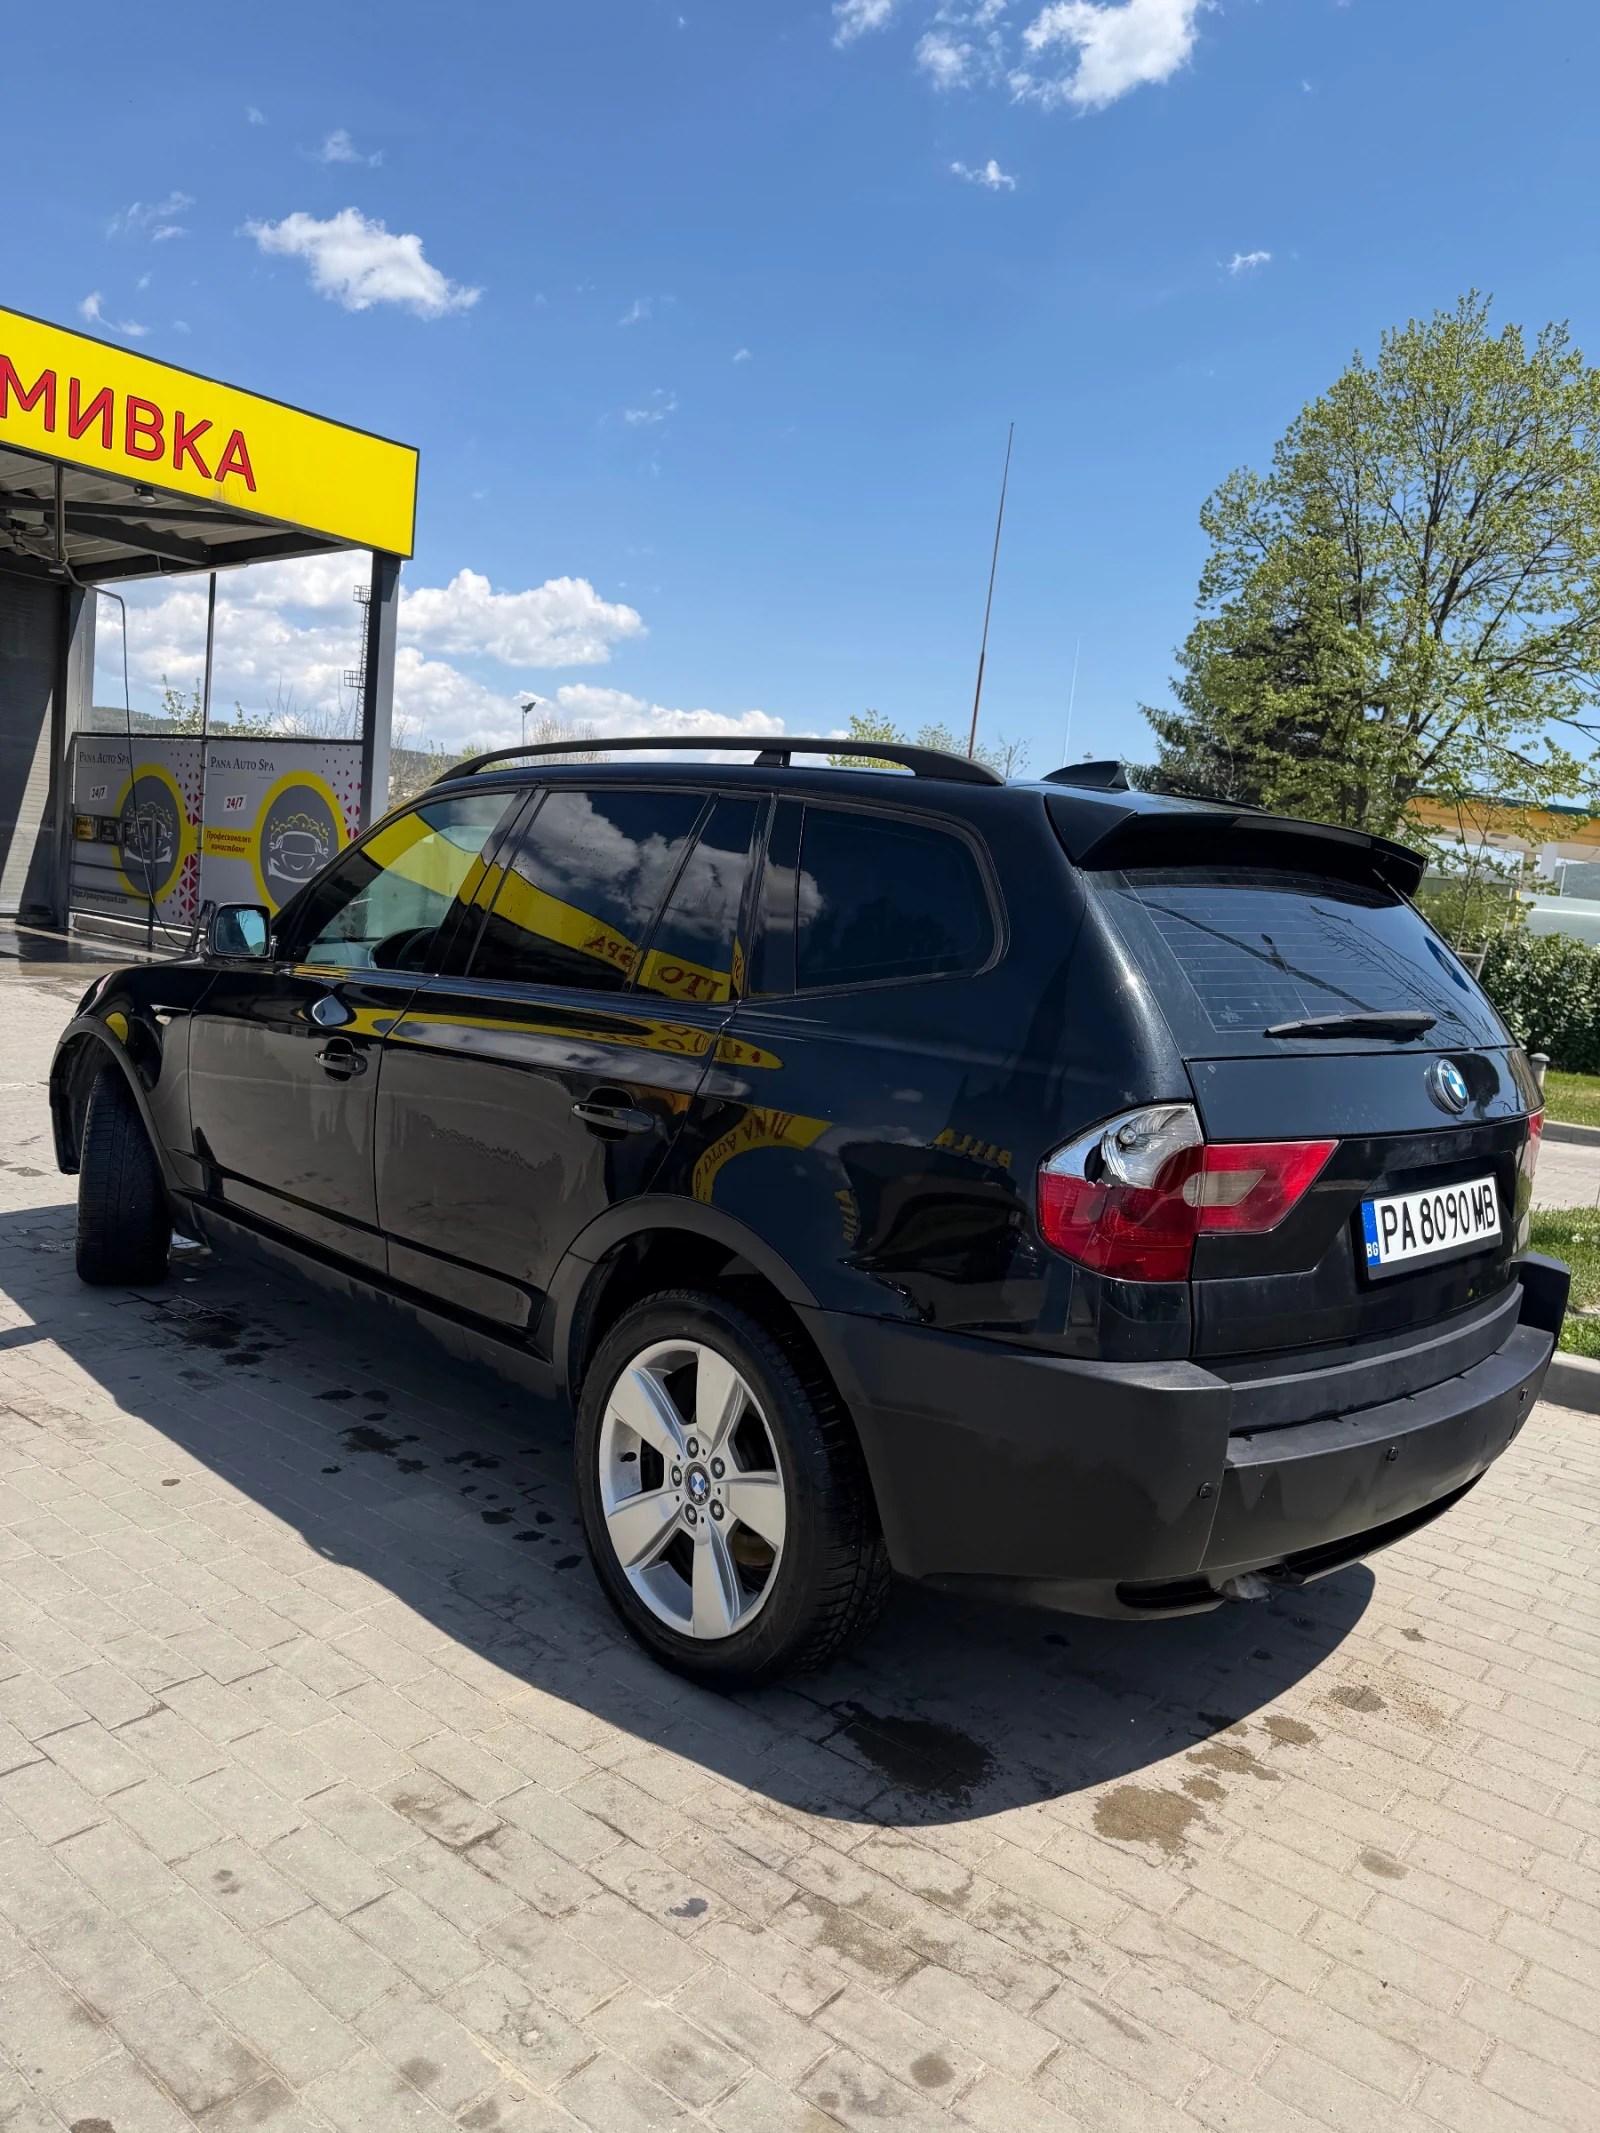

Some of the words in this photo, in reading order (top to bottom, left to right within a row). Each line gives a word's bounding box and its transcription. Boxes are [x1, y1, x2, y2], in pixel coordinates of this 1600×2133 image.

[0, 354, 257, 492] МИВКА
[97, 752, 116, 764] AUTO
[209, 756, 231, 769] PANA
[233, 758, 257, 770] AUTO
[258, 758, 275, 772] SPA
[91, 786, 106, 799] 24/7
[226, 796, 244, 810] 24/7
[1380, 1201, 1418, 1256] PA
[1420, 1190, 1470, 1246] 8090
[1471, 1184, 1496, 1233] MB
[1366, 1242, 1379, 1258] BG
